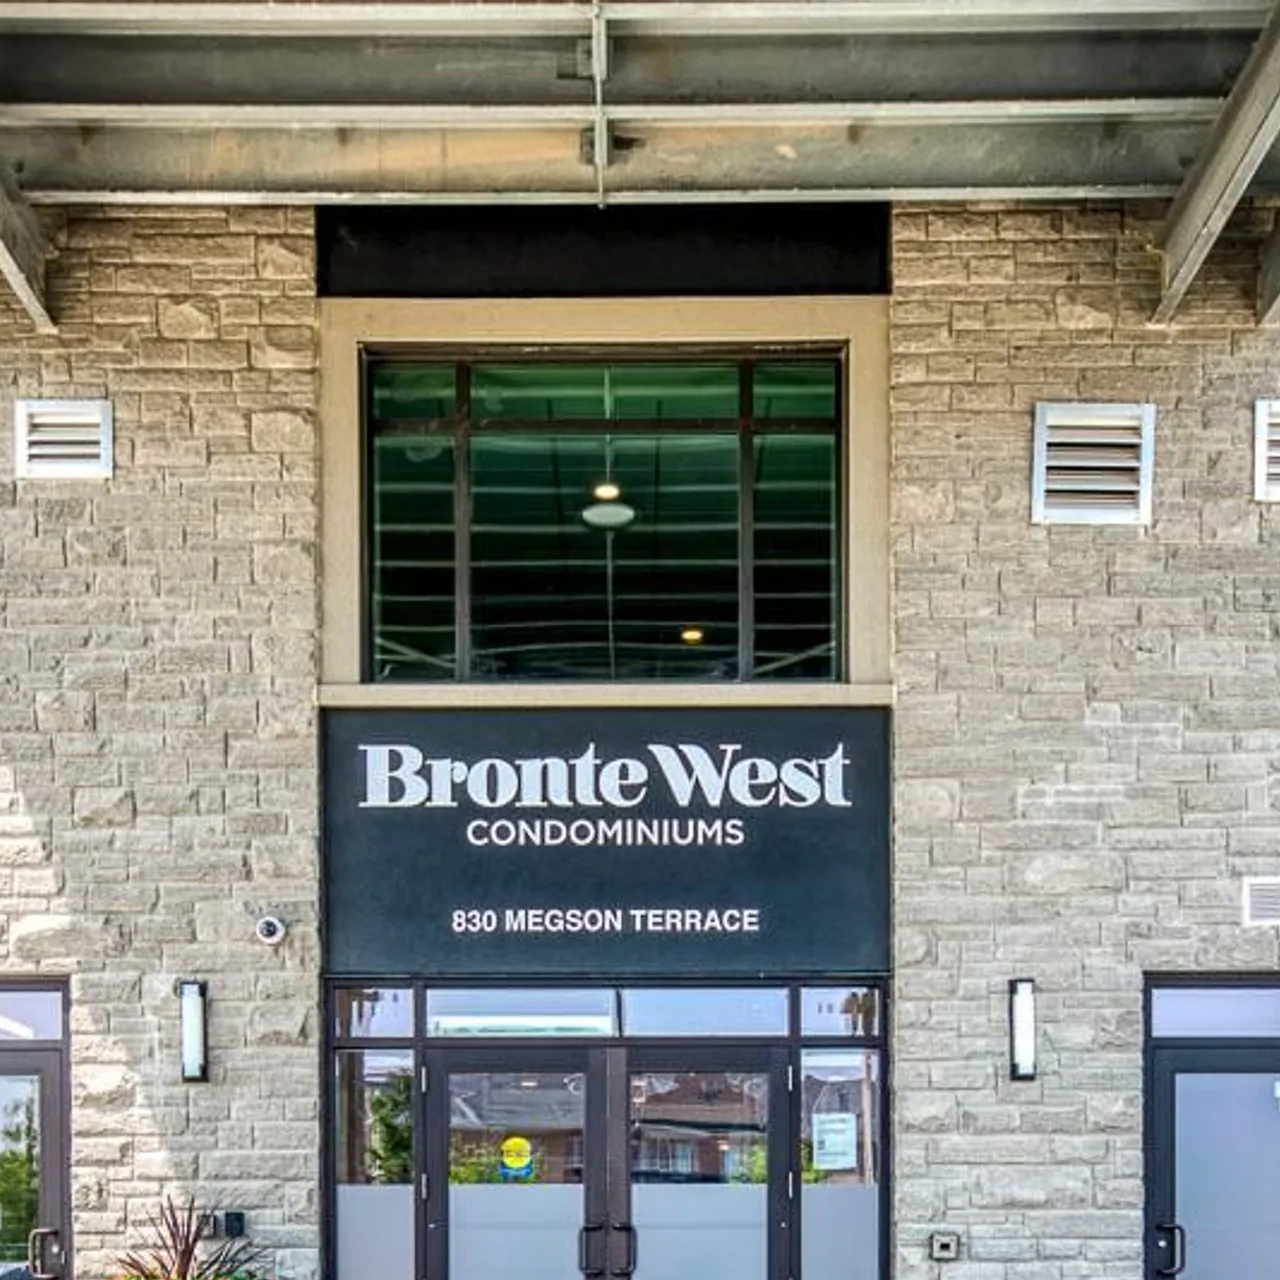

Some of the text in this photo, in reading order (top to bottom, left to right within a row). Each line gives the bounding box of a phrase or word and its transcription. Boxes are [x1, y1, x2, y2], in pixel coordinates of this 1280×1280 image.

[466, 819, 745, 846] CONDOMINIUMS
[451, 908, 759, 933] 830 MEGSON TERRACE
